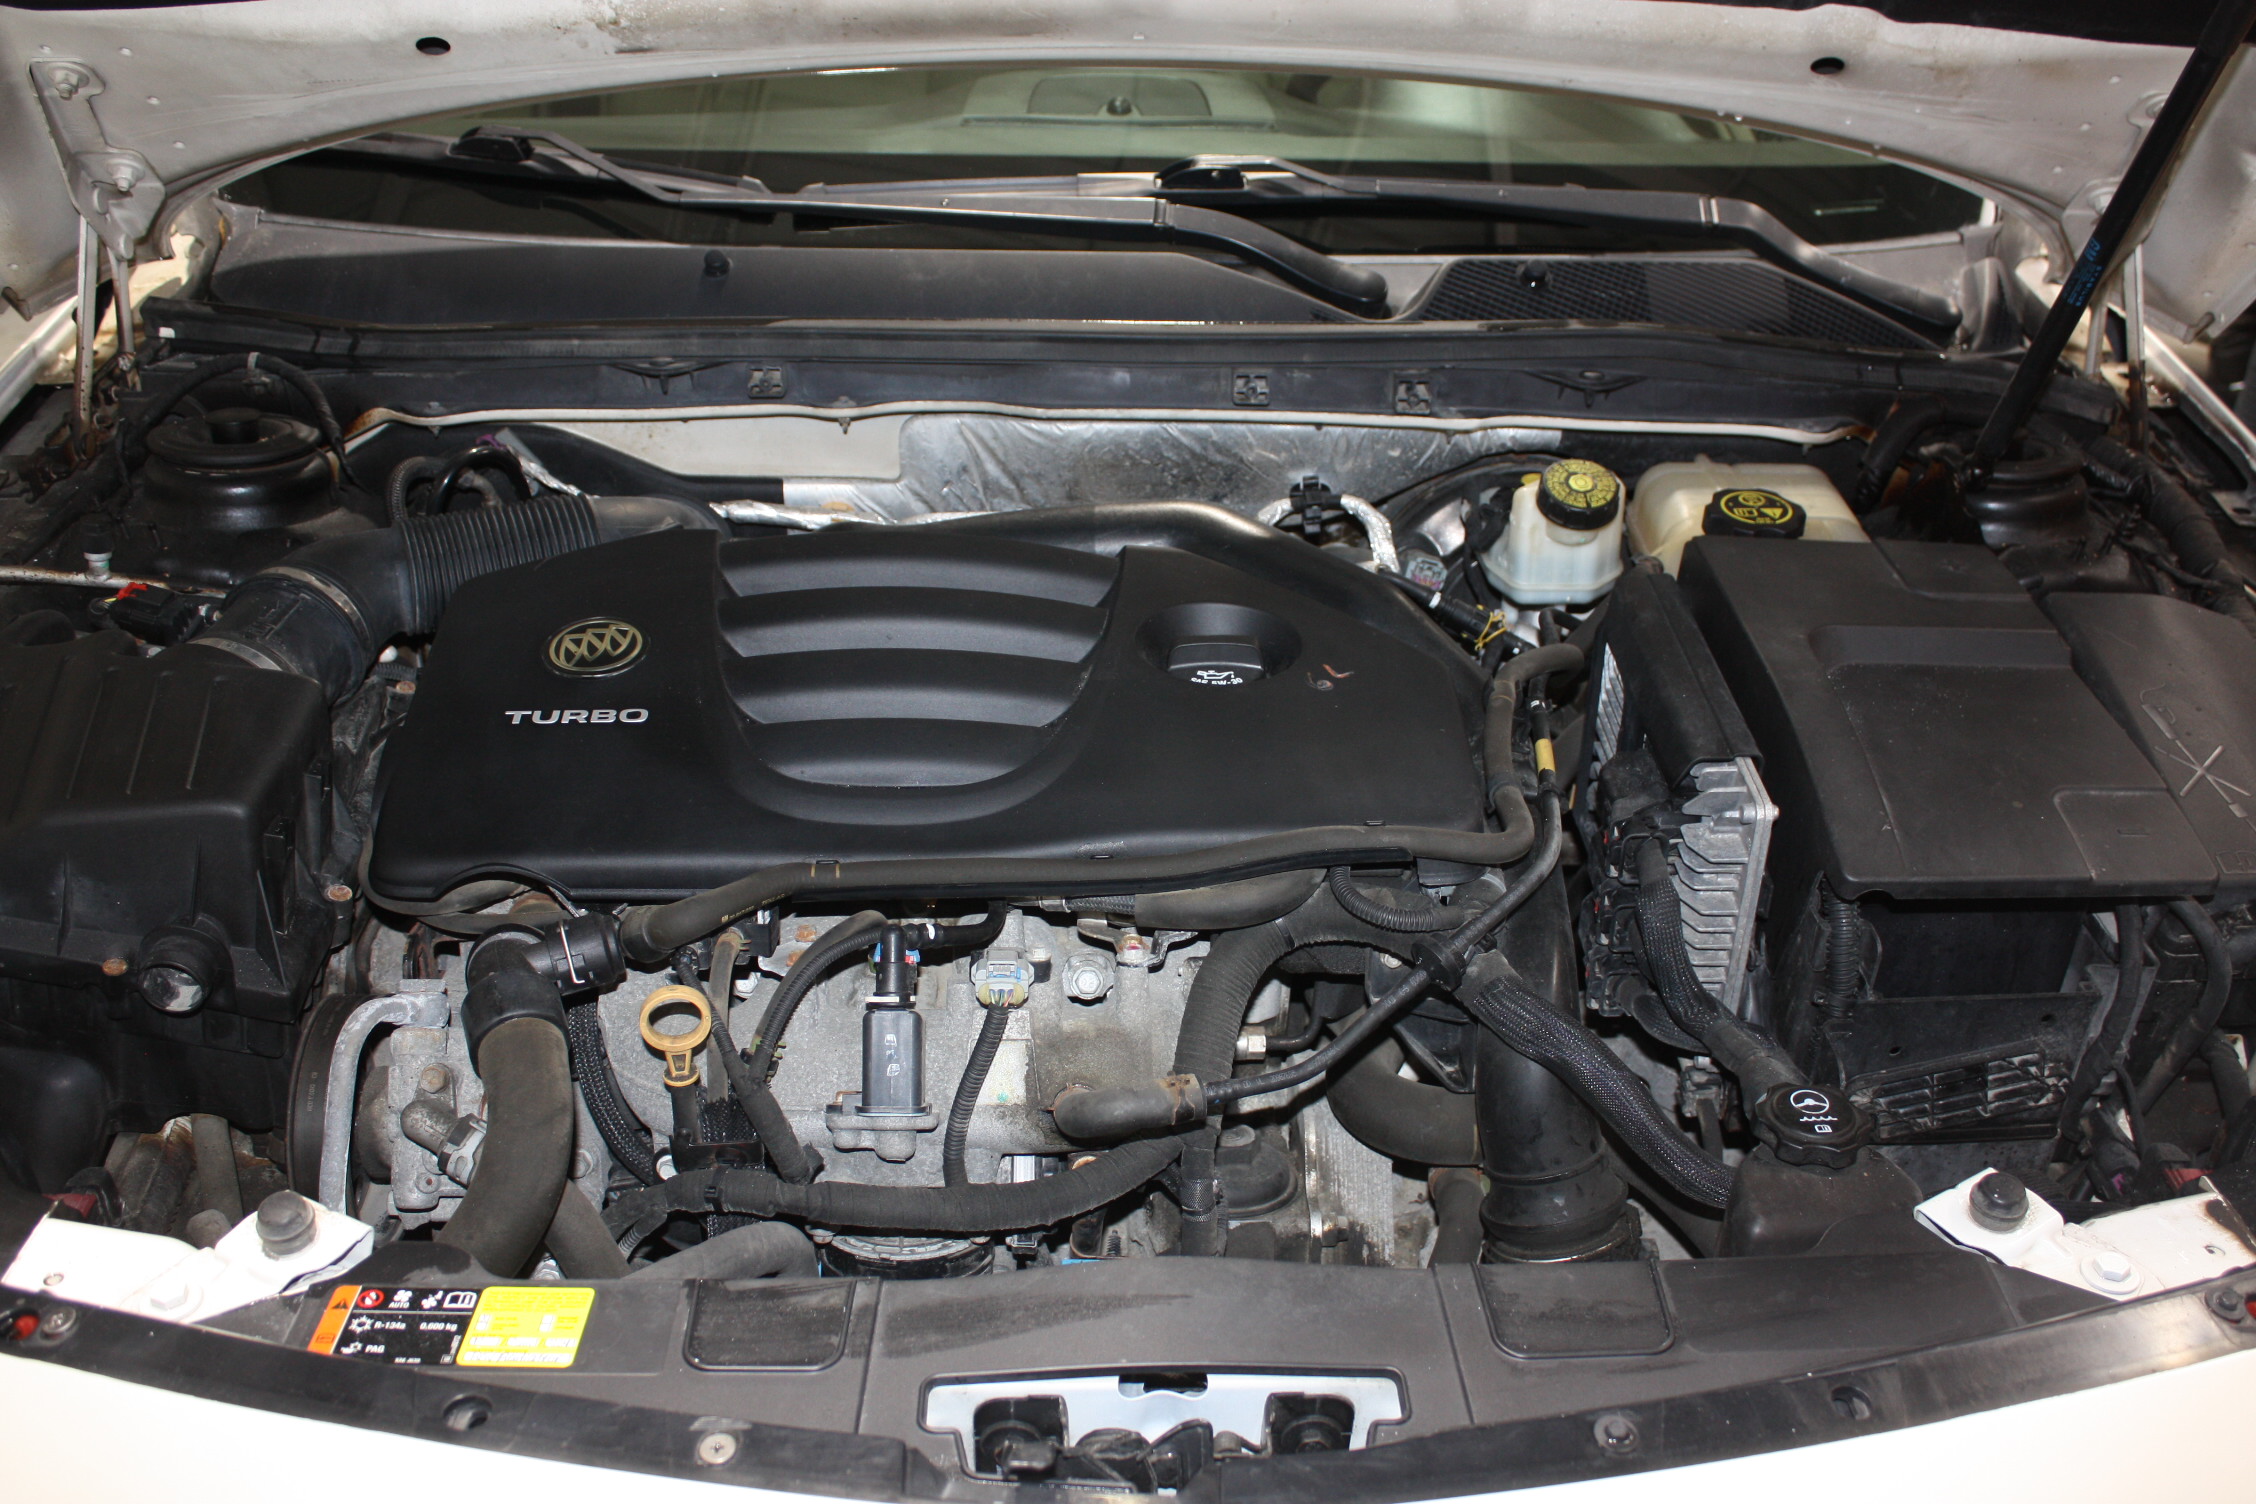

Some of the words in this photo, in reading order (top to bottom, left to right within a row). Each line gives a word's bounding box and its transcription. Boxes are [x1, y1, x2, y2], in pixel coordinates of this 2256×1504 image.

[505, 708, 649, 725] TURBO
[388, 1301, 410, 1309] AUTO
[373, 1320, 406, 1330] R-134a
[420, 1321, 445, 1330] 0.600
[445, 1322, 458, 1332] kg
[365, 1344, 385, 1354] PAG
